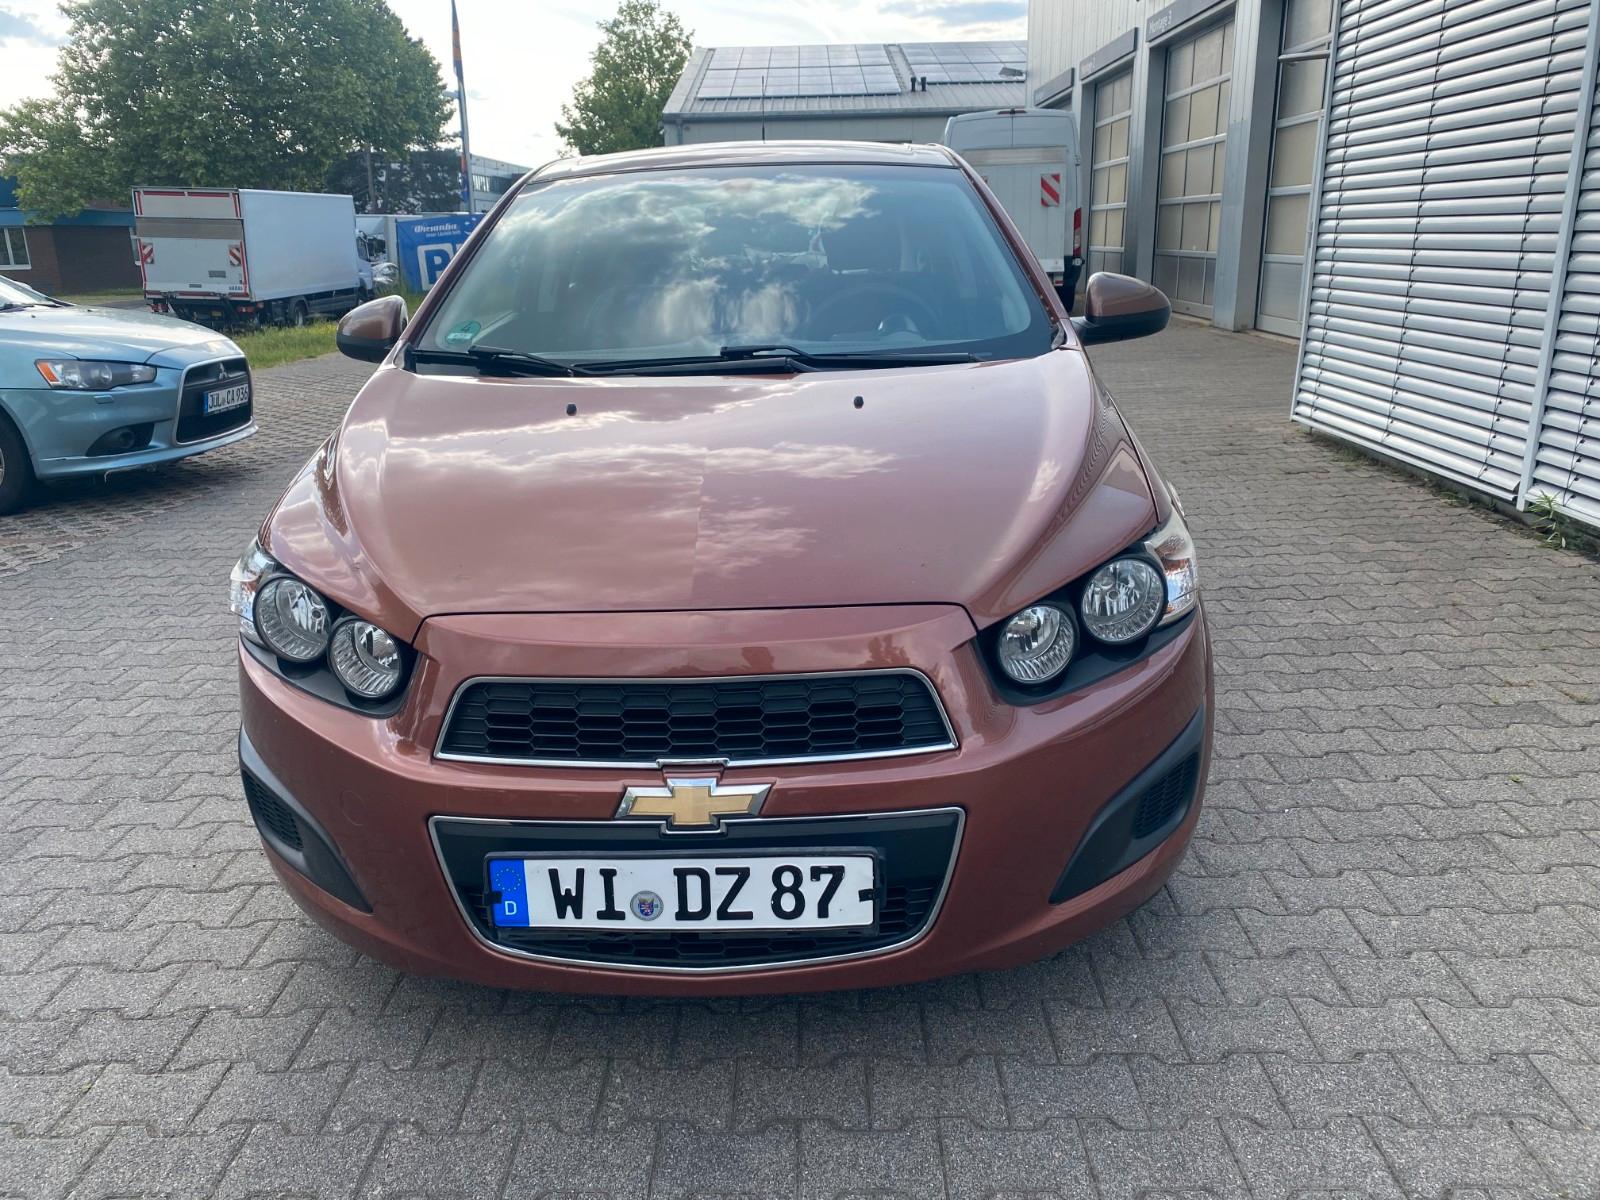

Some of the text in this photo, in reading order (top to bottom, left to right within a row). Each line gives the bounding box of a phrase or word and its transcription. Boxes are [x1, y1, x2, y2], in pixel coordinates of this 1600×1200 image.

[424, 249, 452, 284] P
[226, 389, 235, 404] CA
[548, 867, 626, 920] WI
[673, 866, 754, 921] DZ
[770, 864, 845, 920] 87
[504, 900, 517, 915] D
